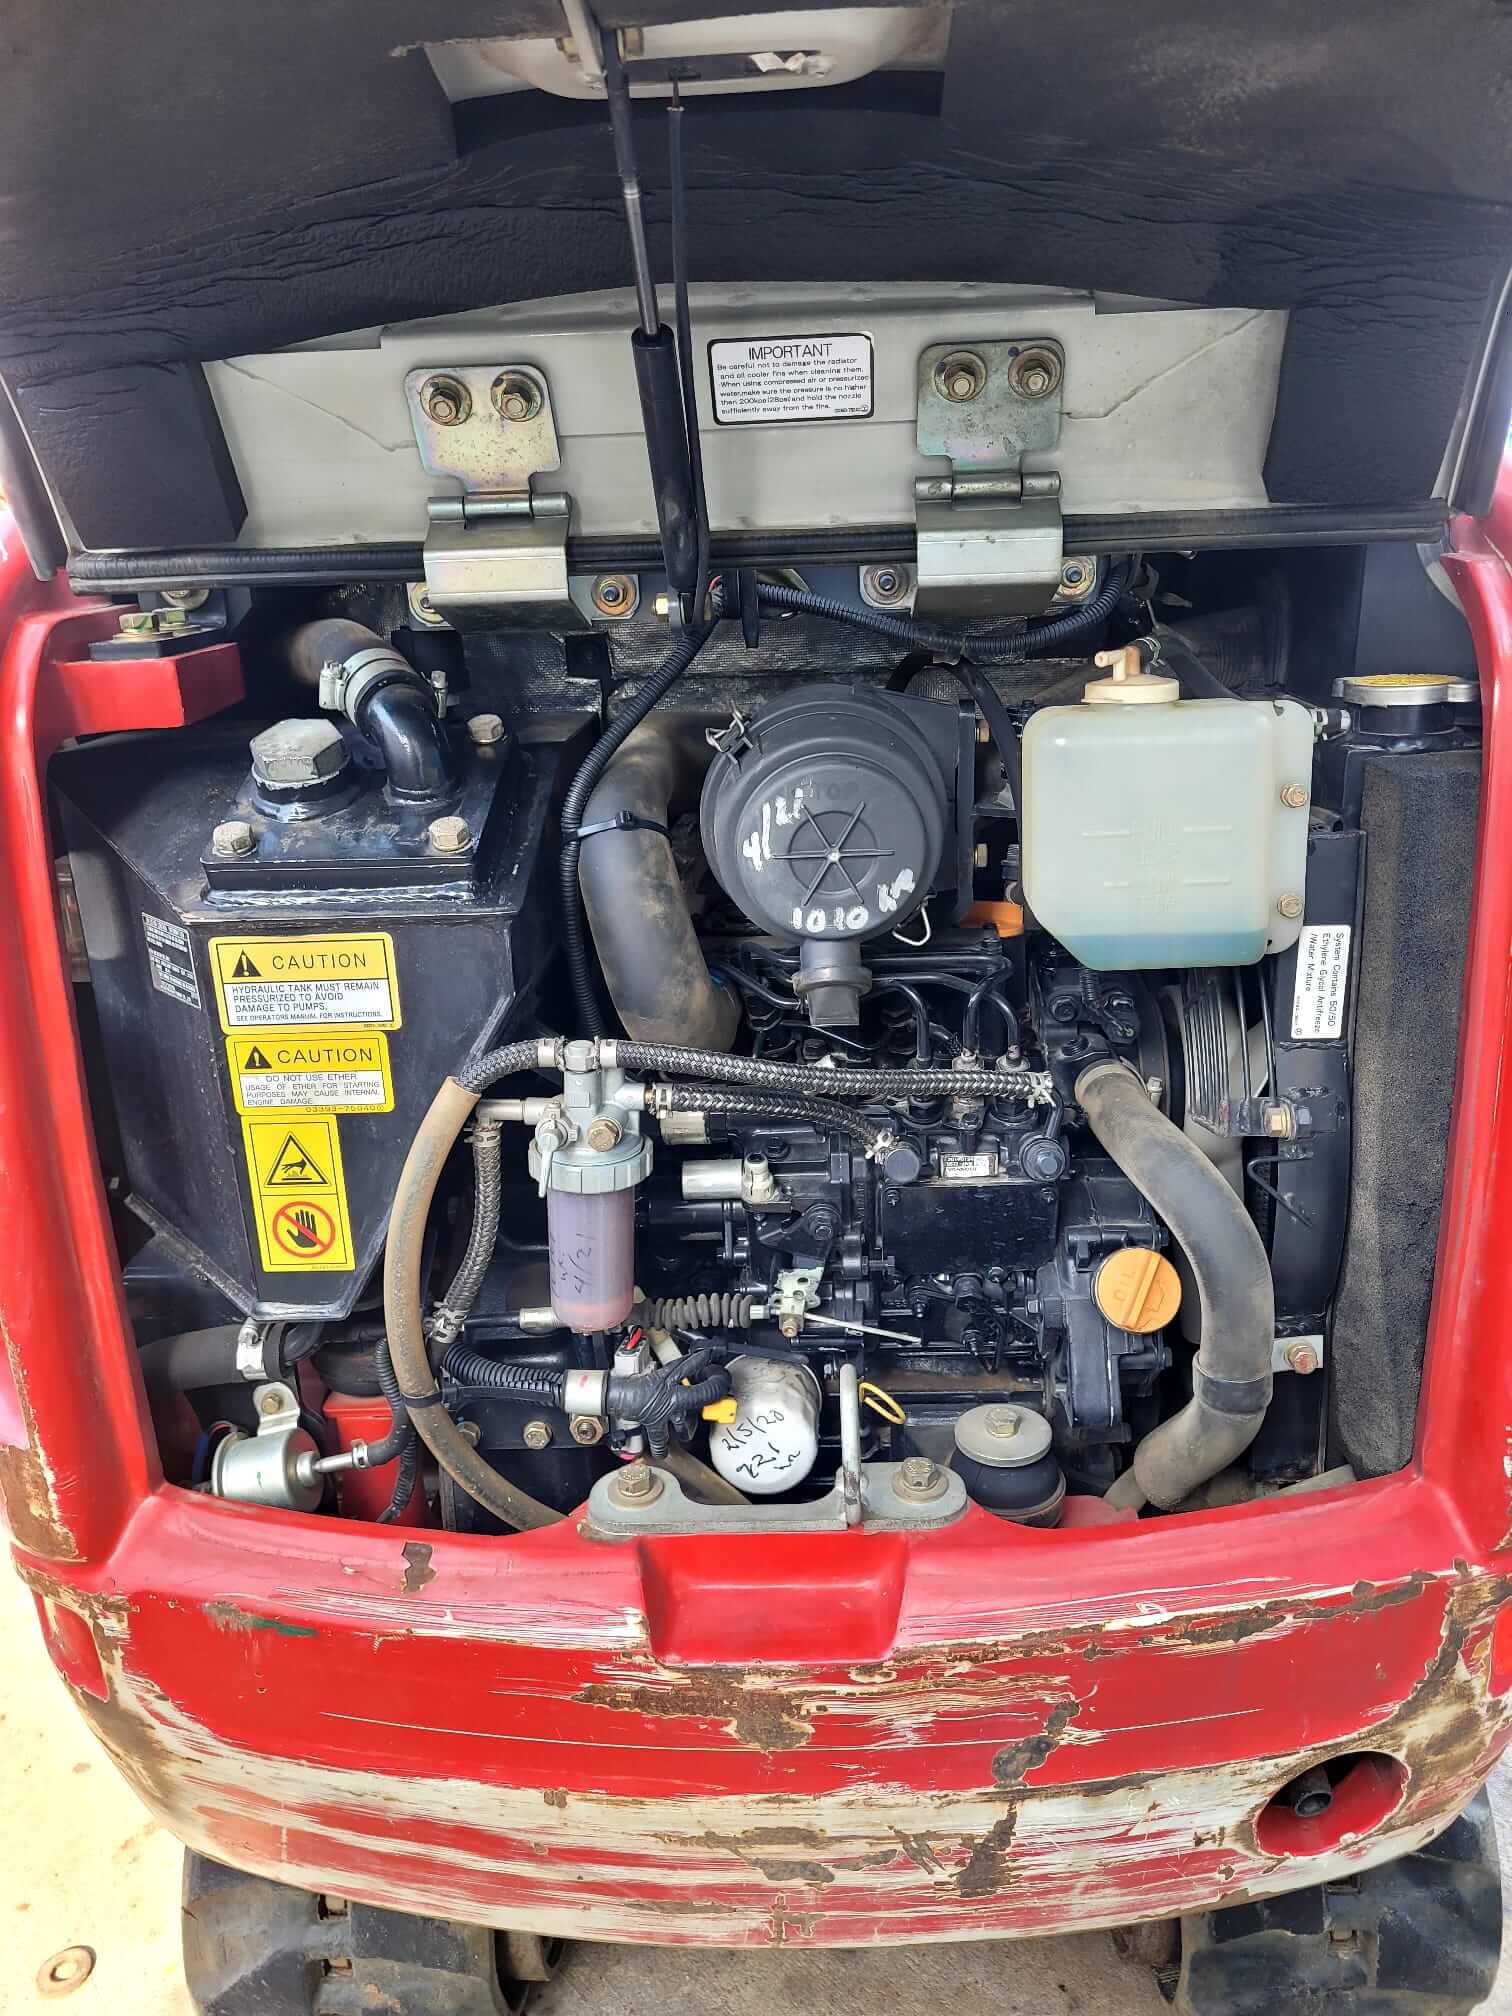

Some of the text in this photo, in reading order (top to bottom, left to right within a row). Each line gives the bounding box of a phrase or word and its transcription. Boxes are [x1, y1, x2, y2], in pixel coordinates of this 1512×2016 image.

[748, 343, 832, 360] IMPORTANT
[729, 362, 755, 370] careful
[827, 357, 857, 365] radiator
[747, 370, 769, 378] cooler
[788, 368, 808, 376] when
[810, 367, 841, 375] cleaning
[764, 378, 806, 386] compressed
[1334, 932, 1344, 961] System
[272, 952, 367, 970] CAUTION
[232, 981, 379, 995] HYDRAULIC TANK MUST REMAIN
[1314, 932, 1331, 1033] Ethylene Glycol Antifreeze
[233, 992, 344, 1003] PRESSURIZED TO AVOID
[235, 1004, 275, 1013] DAMAGE
[278, 1003, 290, 1011] TO
[1328, 1000, 1338, 1027] 50/50
[277, 1047, 372, 1064] CAUTION
[283, 1074, 301, 1082] NOT
[305, 1073, 324, 1081] USE
[276, 1083, 287, 1091] OF
[343, 1081, 380, 1089] STARTING
[314, 1089, 339, 1097] CAUSE
[1113, 1271, 1135, 1302] OIL
[721, 1409, 785, 1451] 2/5/20
